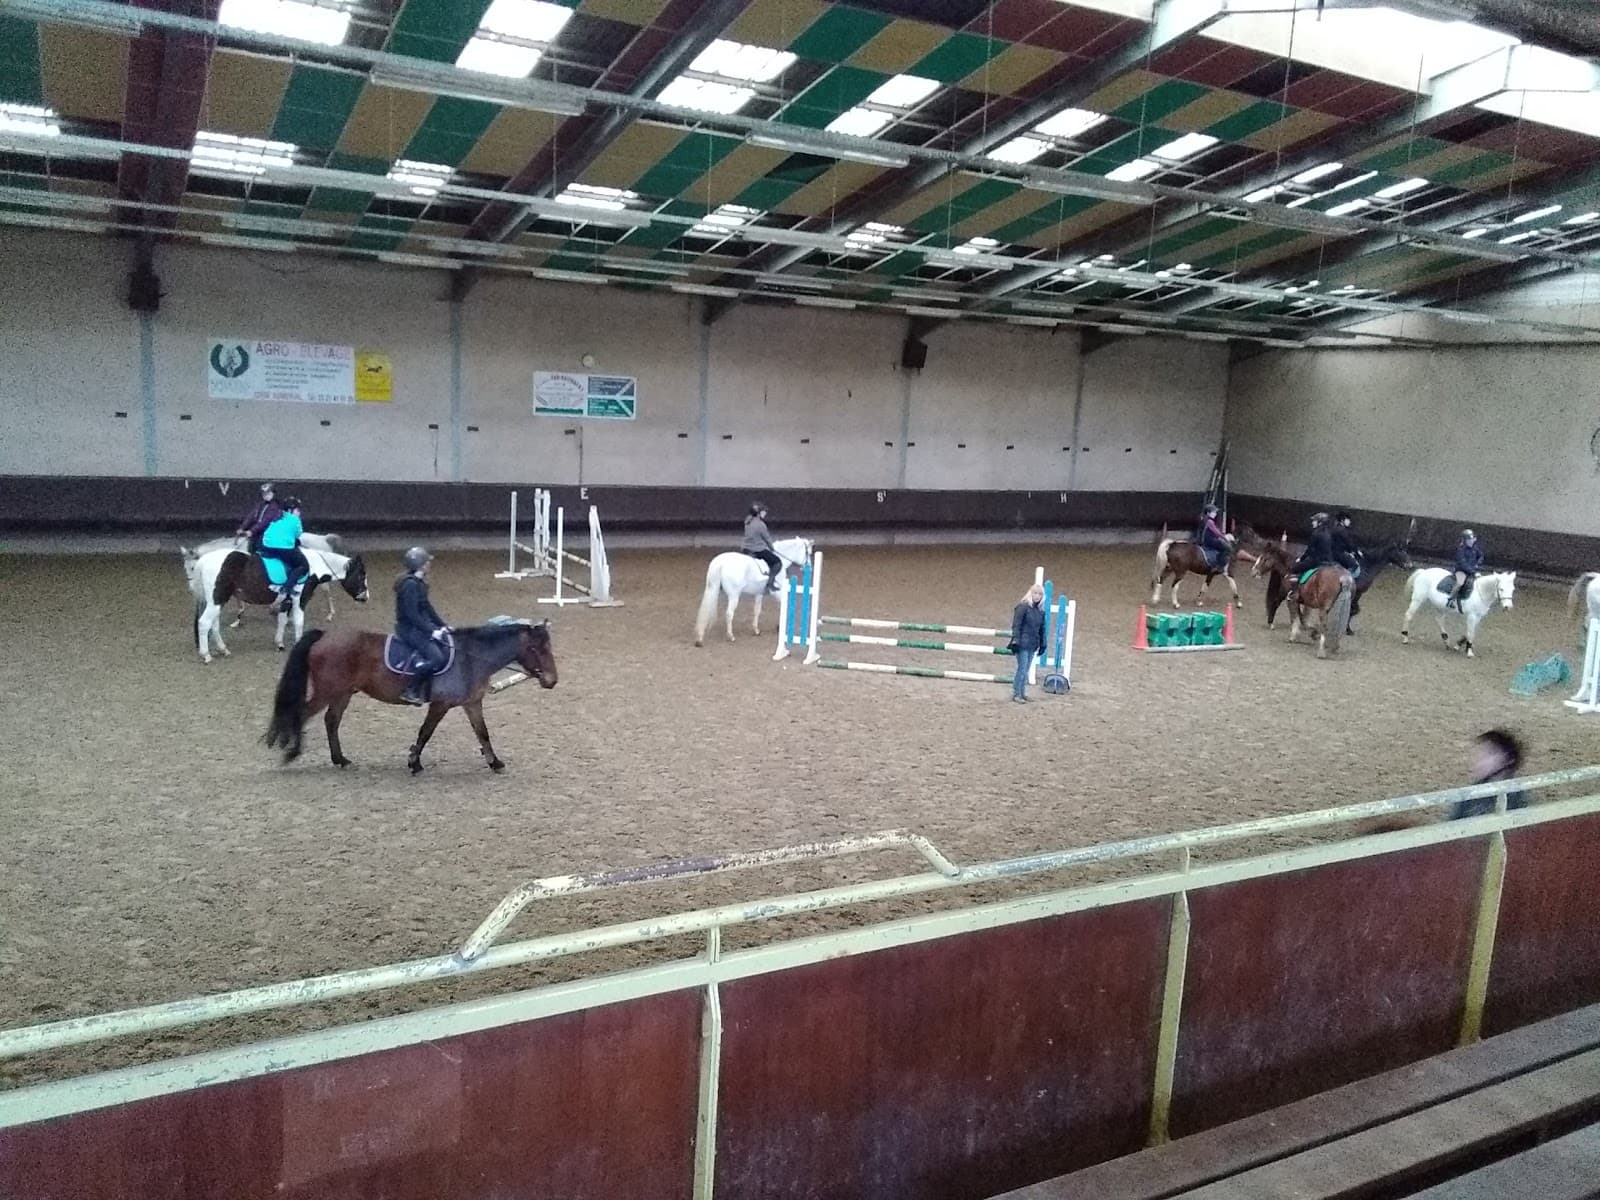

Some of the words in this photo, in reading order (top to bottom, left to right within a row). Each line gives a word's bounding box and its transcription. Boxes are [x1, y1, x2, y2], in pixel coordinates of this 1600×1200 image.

[256, 342, 290, 356] AGRO
[218, 482, 229, 495] V
[580, 487, 589, 500] E
